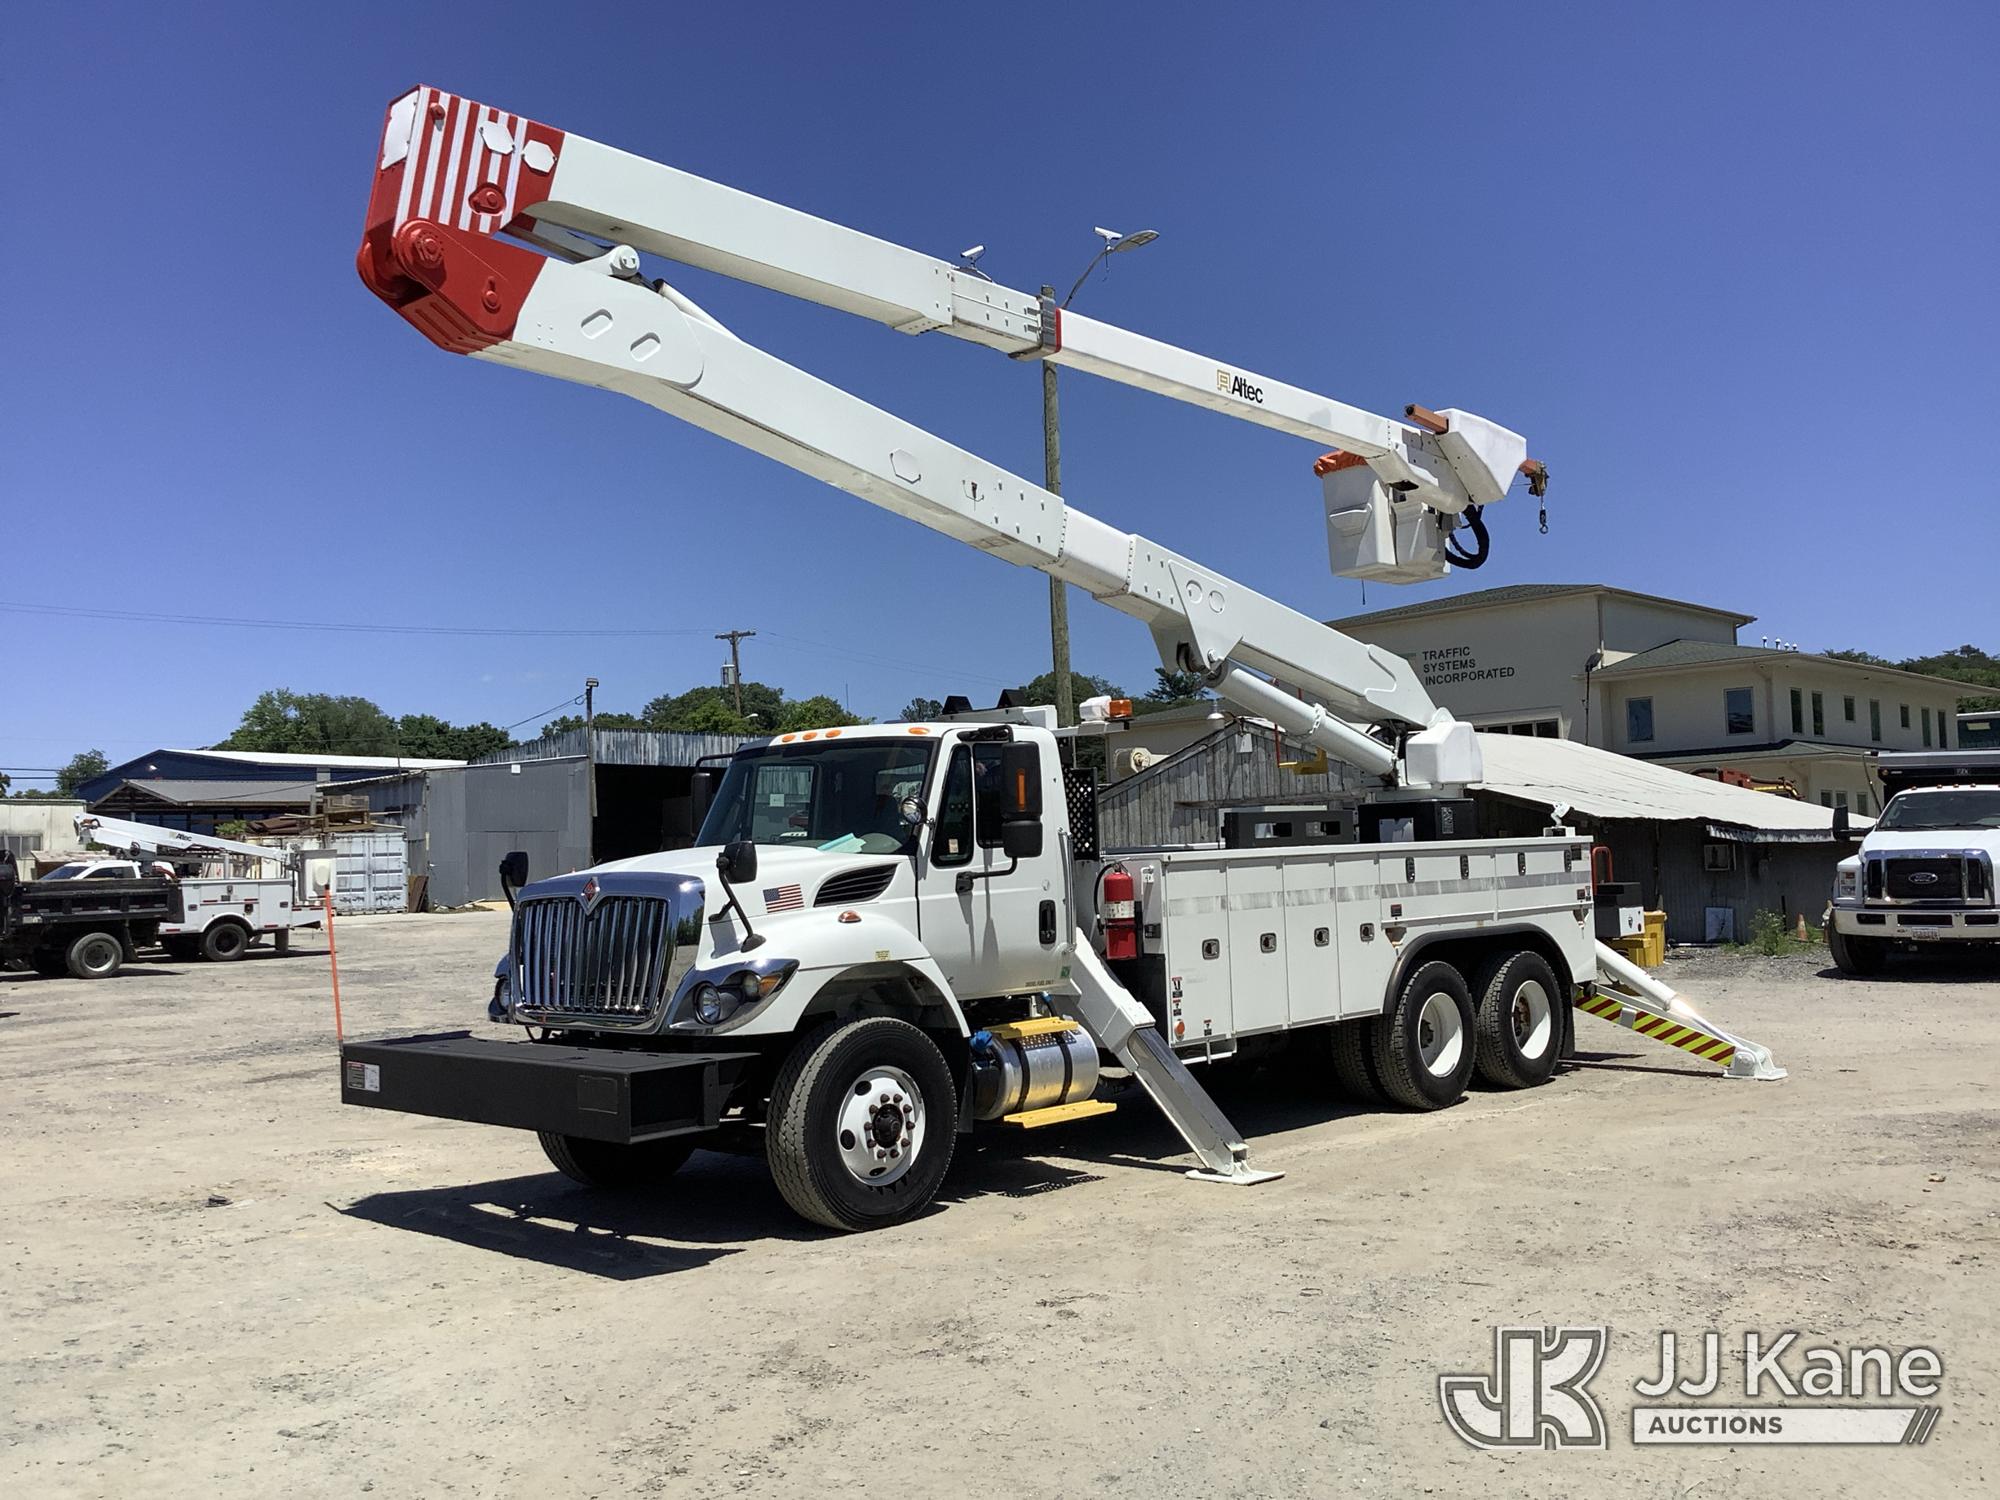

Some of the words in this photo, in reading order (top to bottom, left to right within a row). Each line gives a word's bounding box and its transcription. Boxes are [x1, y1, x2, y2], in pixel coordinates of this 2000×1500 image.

[1231, 375, 1263, 404] Altec
[1422, 646, 1471, 661] TRAFFIC
[1423, 658, 1476, 674] SYSTEMS
[1425, 666, 1515, 686] INCORPORATED
